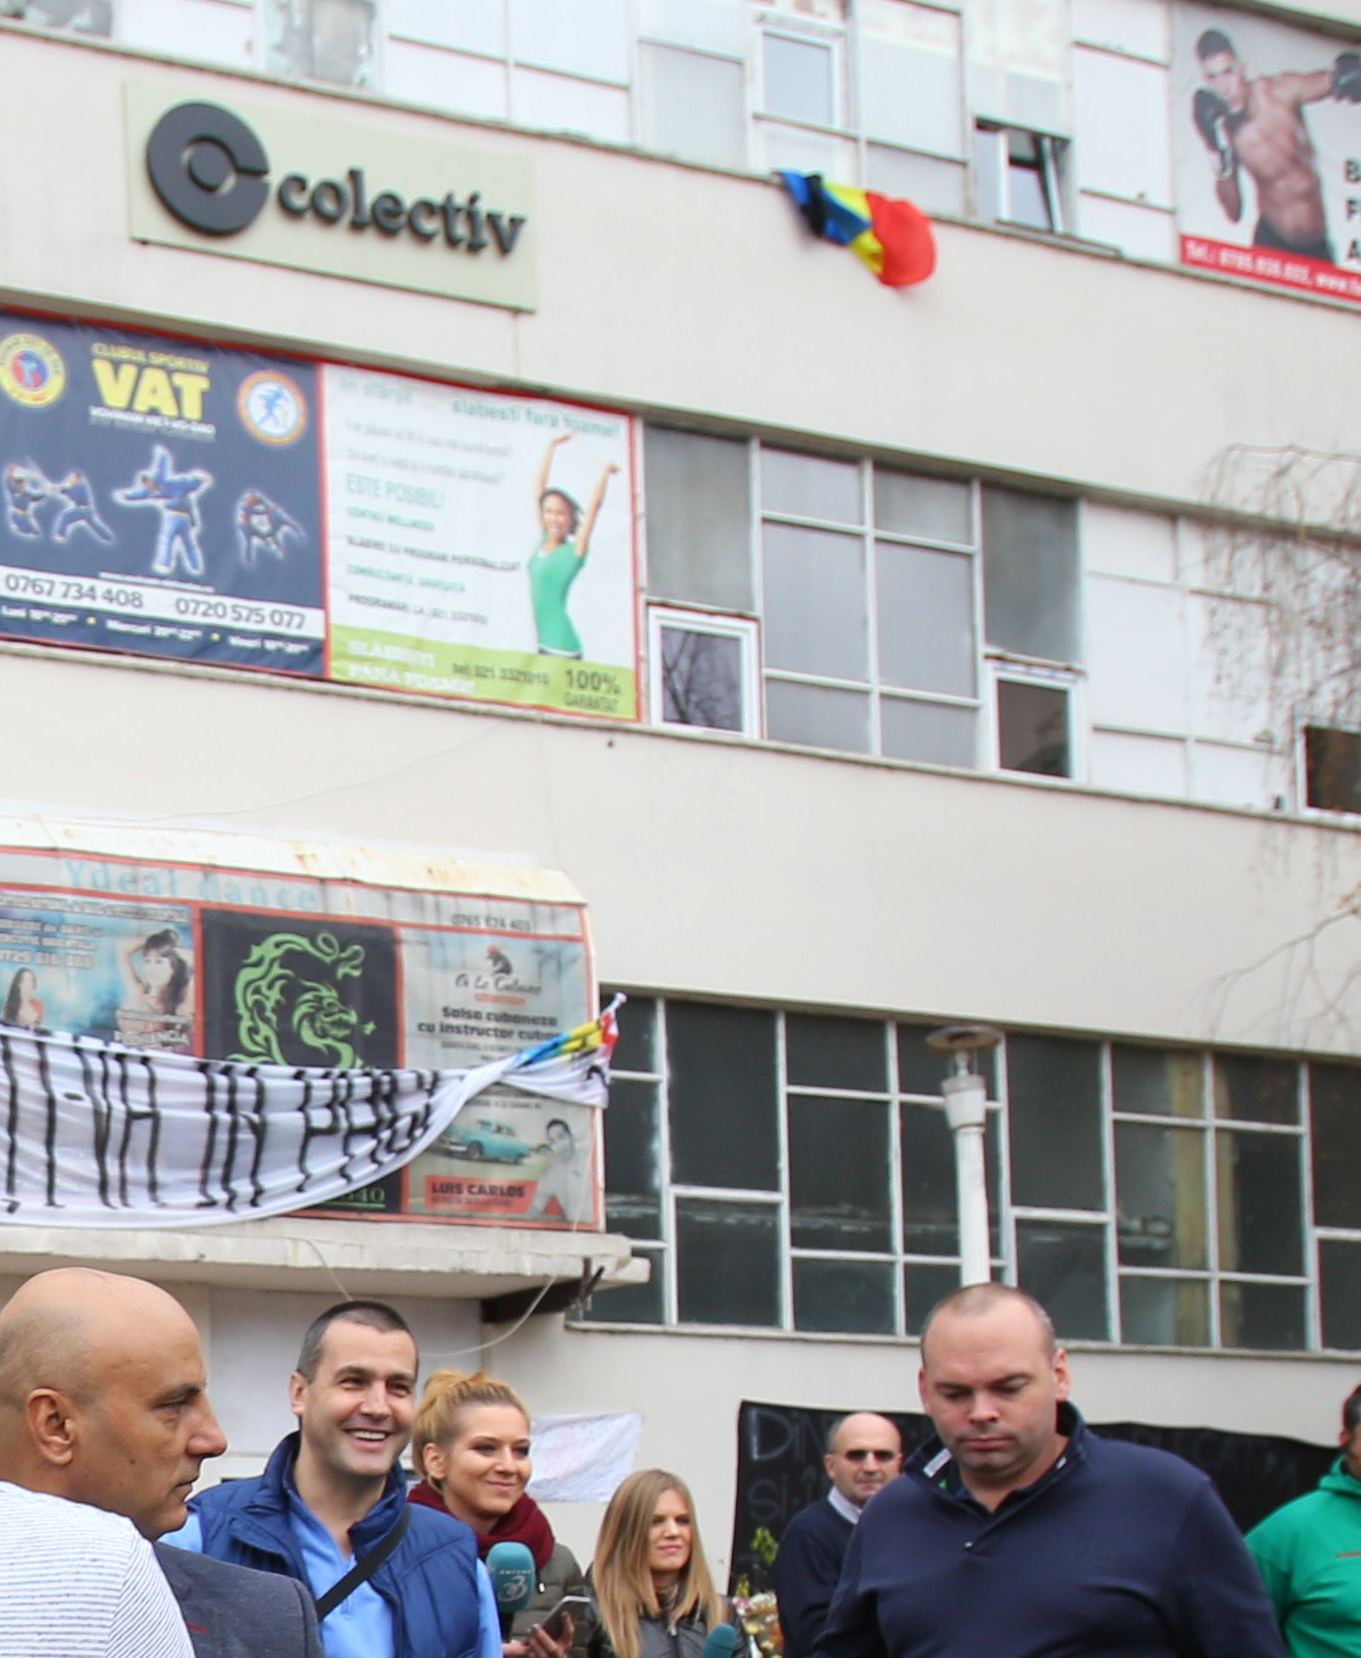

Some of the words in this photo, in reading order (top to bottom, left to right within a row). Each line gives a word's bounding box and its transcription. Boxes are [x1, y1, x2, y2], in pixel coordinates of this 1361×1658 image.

[277, 164, 527, 258] colectiv
[91, 357, 211, 421] VAT
[5, 574, 55, 598] 0767
[61, 581, 97, 603] 734
[100, 587, 143, 609] 408
[175, 597, 226, 620] 0720
[269, 609, 306, 630] 077
[564, 668, 621, 696] 100%
[198, 872, 318, 912] dance
[417, 1022, 435, 1033] cu
[440, 1022, 515, 1038] instructor
[442, 1006, 484, 1020] Salsa
[431, 1181, 463, 1196] LUIS
[466, 1183, 526, 1199] CARLOS
